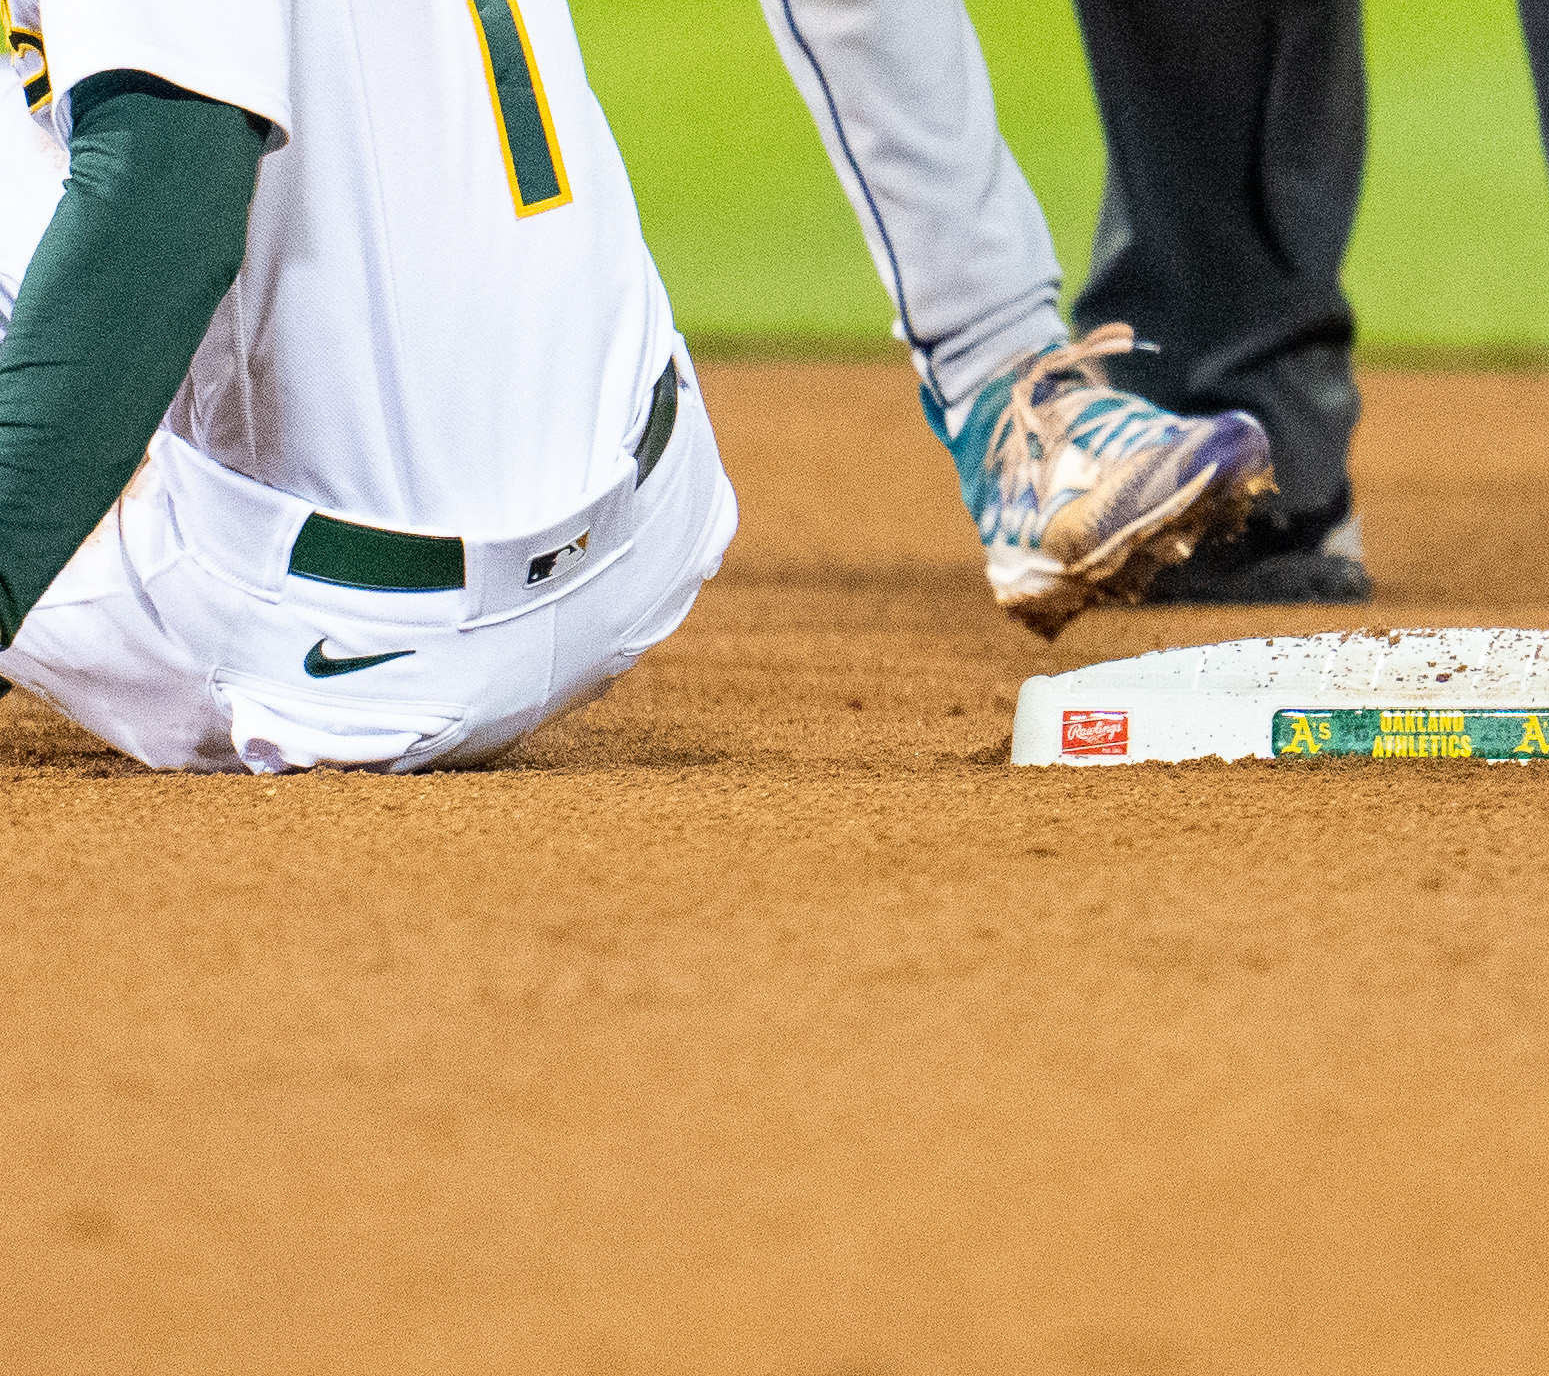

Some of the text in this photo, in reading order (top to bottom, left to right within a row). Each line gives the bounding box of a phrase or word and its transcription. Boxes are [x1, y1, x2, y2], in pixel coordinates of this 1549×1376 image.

[1379, 710, 1465, 733] OAKLAND
[1281, 715, 1332, 754] A's
[1372, 734, 1473, 759] ATHLETICS
